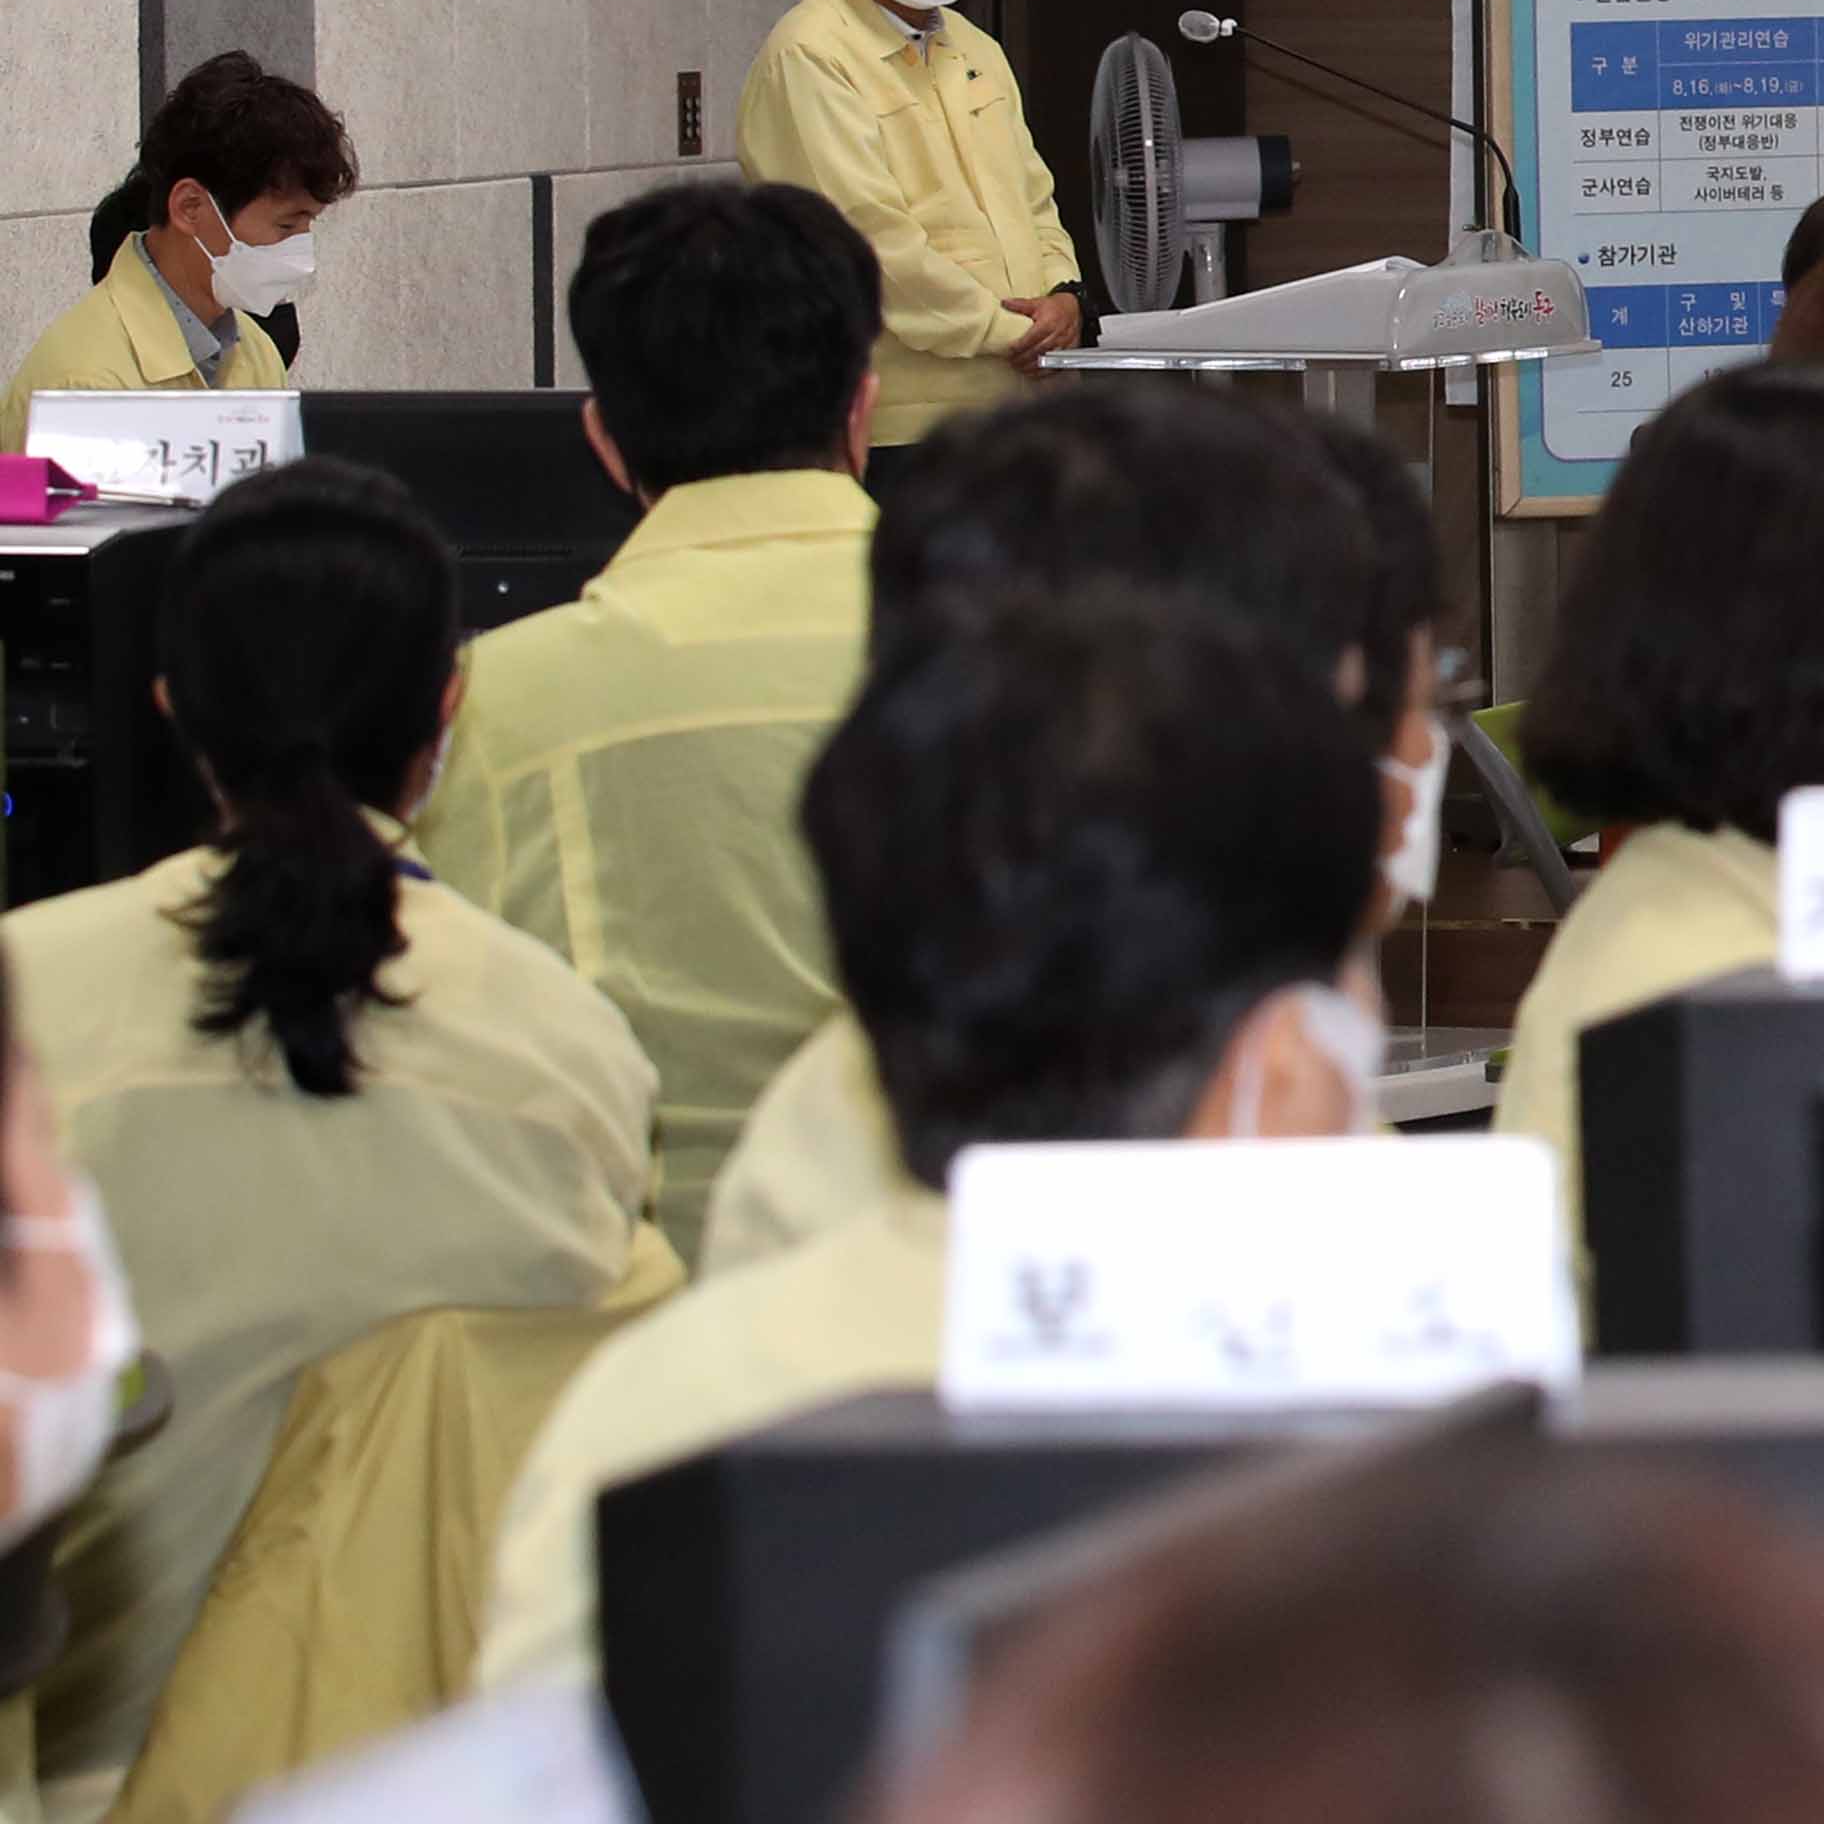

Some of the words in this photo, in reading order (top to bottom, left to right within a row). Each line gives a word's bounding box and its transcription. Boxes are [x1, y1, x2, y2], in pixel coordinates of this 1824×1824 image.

[1684, 30, 1789, 50] 위기관리연습
[1679, 114, 1736, 132] 전쟁이전
[1741, 113, 1797, 131] 위기대응
[1580, 128, 1650, 147] 정부연습
[1698, 134, 1779, 154] (정부대응반)
[1582, 177, 1651, 198] 군사연습
[1694, 184, 1765, 203] 사이버테러
[1769, 183, 1785, 201] 등
[1598, 245, 1677, 268] 참가기관
[1679, 293, 1697, 313] 구
[1729, 289, 1746, 311] 및
[1611, 307, 1629, 327] 계
[1678, 315, 1749, 336] 산하기관
[1611, 370, 1633, 389] 25
